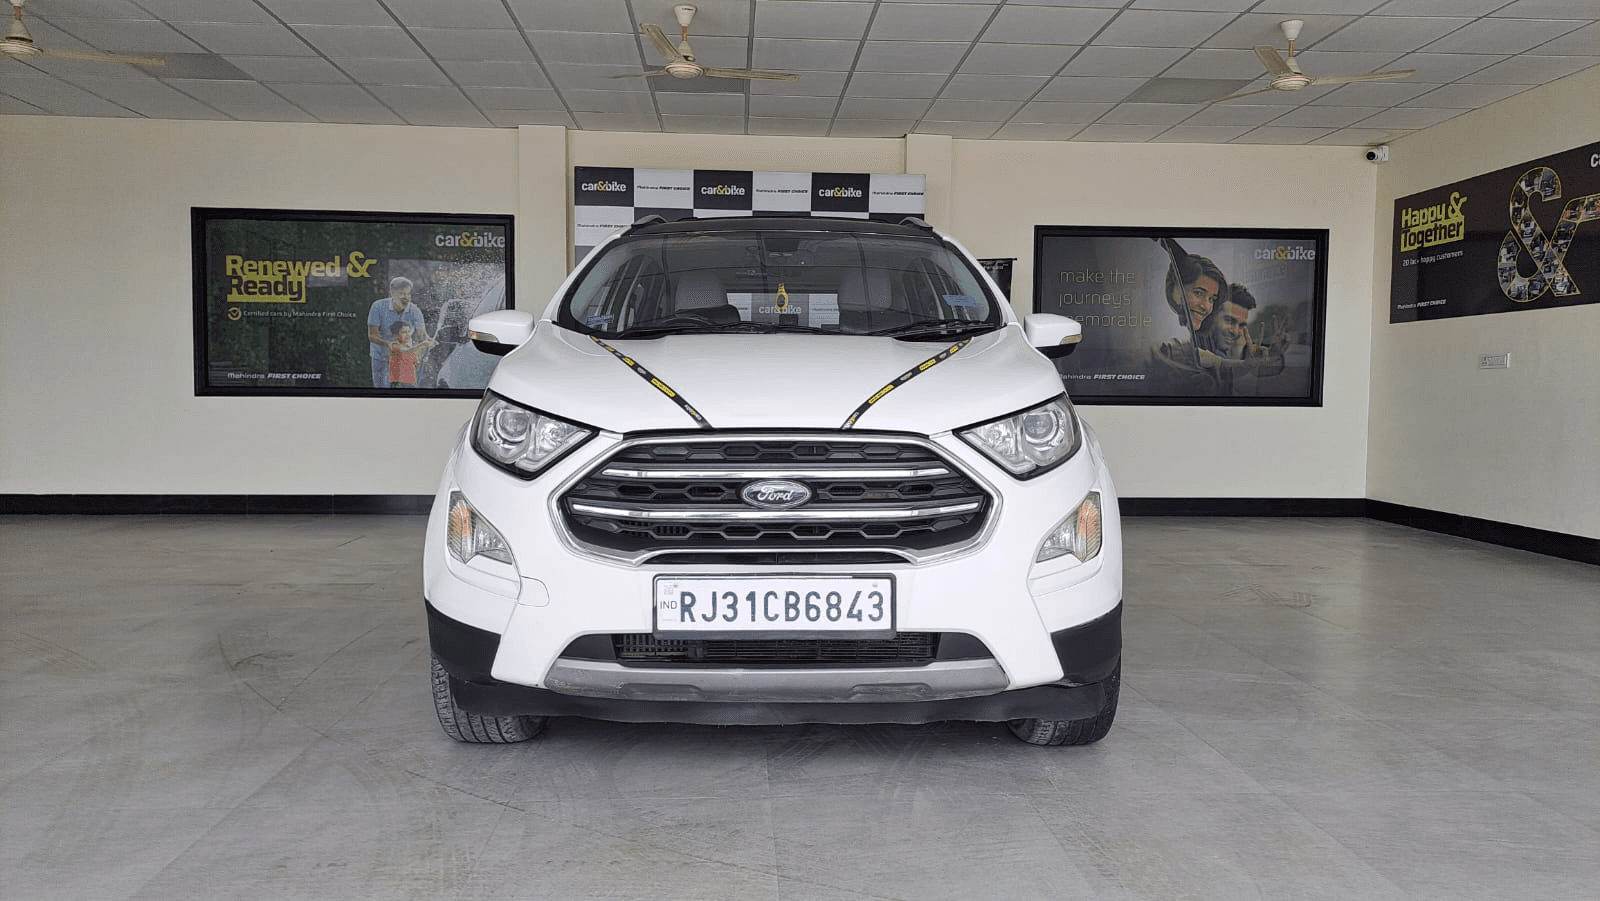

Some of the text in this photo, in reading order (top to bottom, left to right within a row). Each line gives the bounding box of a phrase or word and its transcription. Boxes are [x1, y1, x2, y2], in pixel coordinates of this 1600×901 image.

[581, 180, 627, 193] car&bike
[701, 184, 745, 196] car&bike
[818, 186, 863, 198] car&bike
[1402, 191, 1468, 228] Happy &
[435, 231, 506, 248] car&bike
[1400, 221, 1463, 248] Together
[1254, 246, 1316, 261] car&bike
[225, 250, 378, 278] Renewed &
[1060, 267, 1137, 284] make the
[230, 275, 304, 301] Ready
[1059, 290, 1132, 309] journeys
[1067, 311, 1153, 327] emorable
[757, 485, 795, 502] Ford
[659, 590, 884, 623] IND RJ31CB6843
